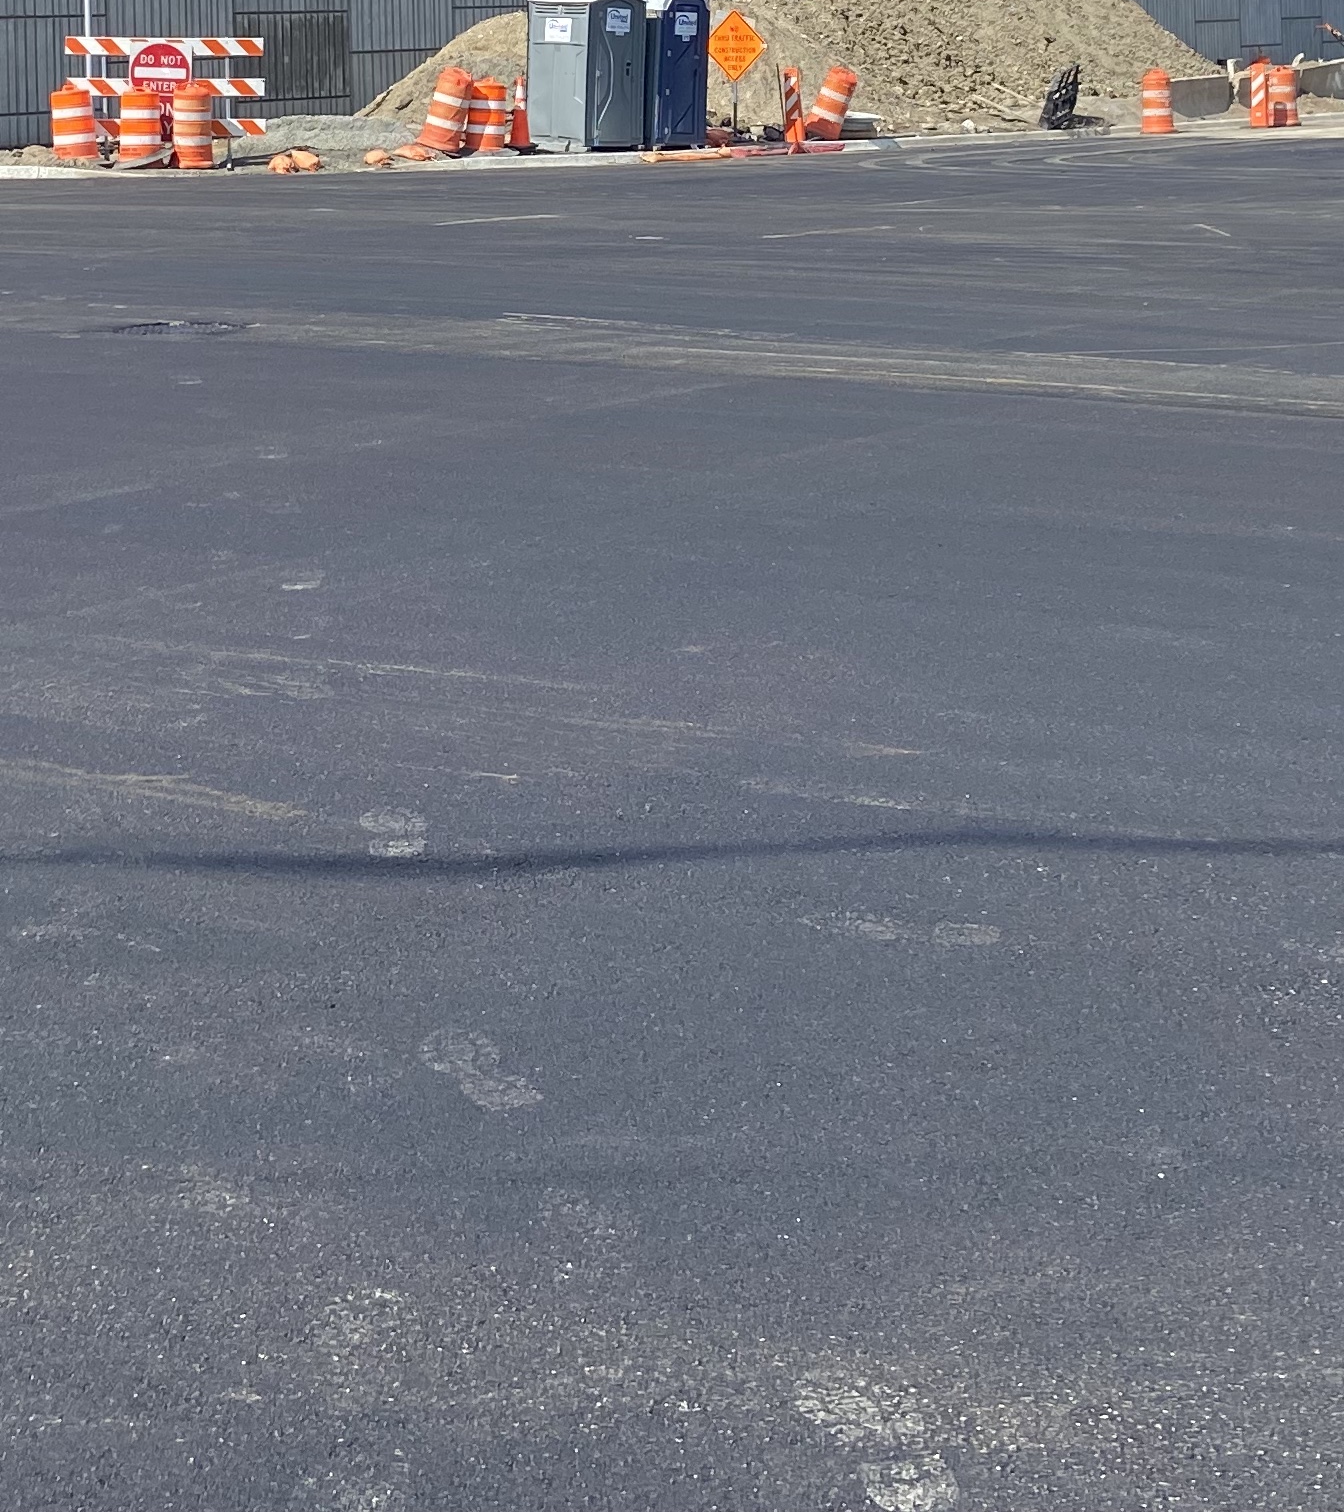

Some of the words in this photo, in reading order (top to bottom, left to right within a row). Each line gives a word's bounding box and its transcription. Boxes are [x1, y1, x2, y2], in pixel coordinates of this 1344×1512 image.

[140, 54, 154, 65] DO
[160, 55, 183, 65] NOT
[143, 81, 176, 91] ENTER
